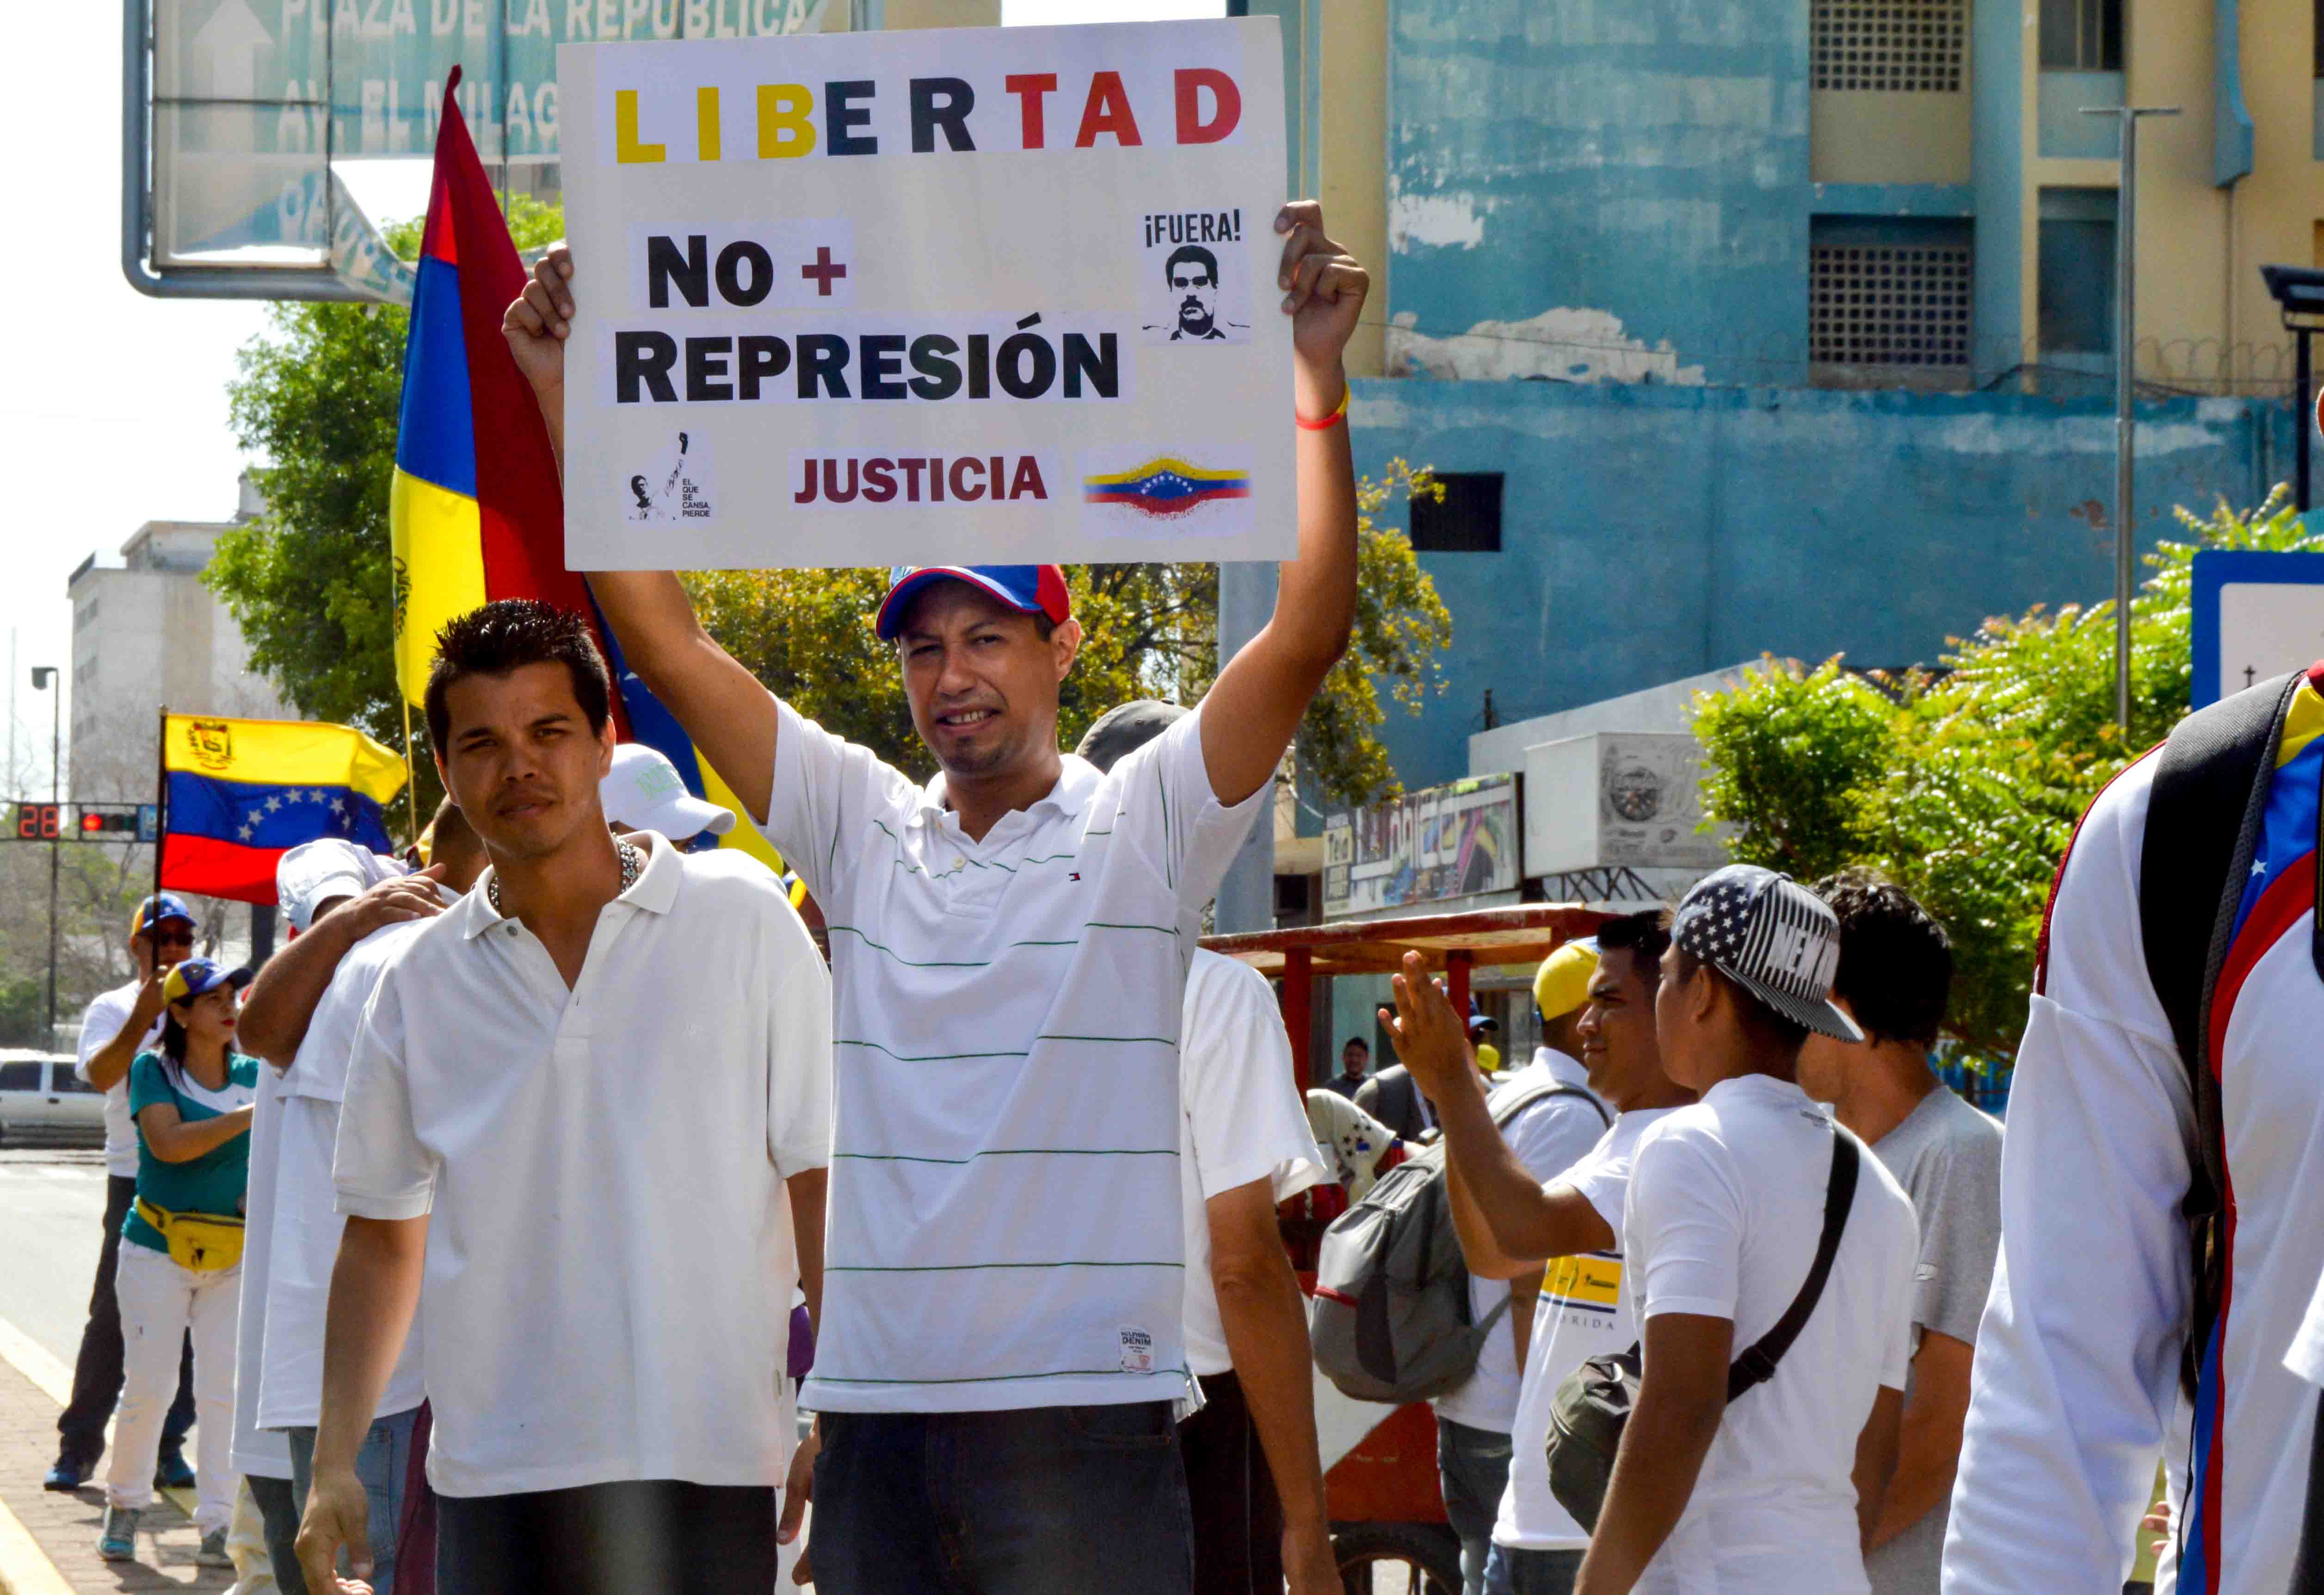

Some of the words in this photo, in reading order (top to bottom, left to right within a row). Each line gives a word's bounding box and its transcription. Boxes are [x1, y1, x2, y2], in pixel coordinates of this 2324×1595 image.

[282, 0, 417, 37] PLAZA
[431, 0, 486, 37] DE
[504, 0, 552, 37] LA
[362, 79, 410, 146] EL
[615, 68, 1241, 163] LIBERTAD
[1145, 209, 1240, 248] ¡FUERA!
[647, 235, 774, 309] NO
[615, 312, 1119, 403] REPRESIÓN
[795, 456, 1048, 504] JUSTICIA
[18, 806, 60, 837] 28
[1122, 1336, 1151, 1347] DENIM
